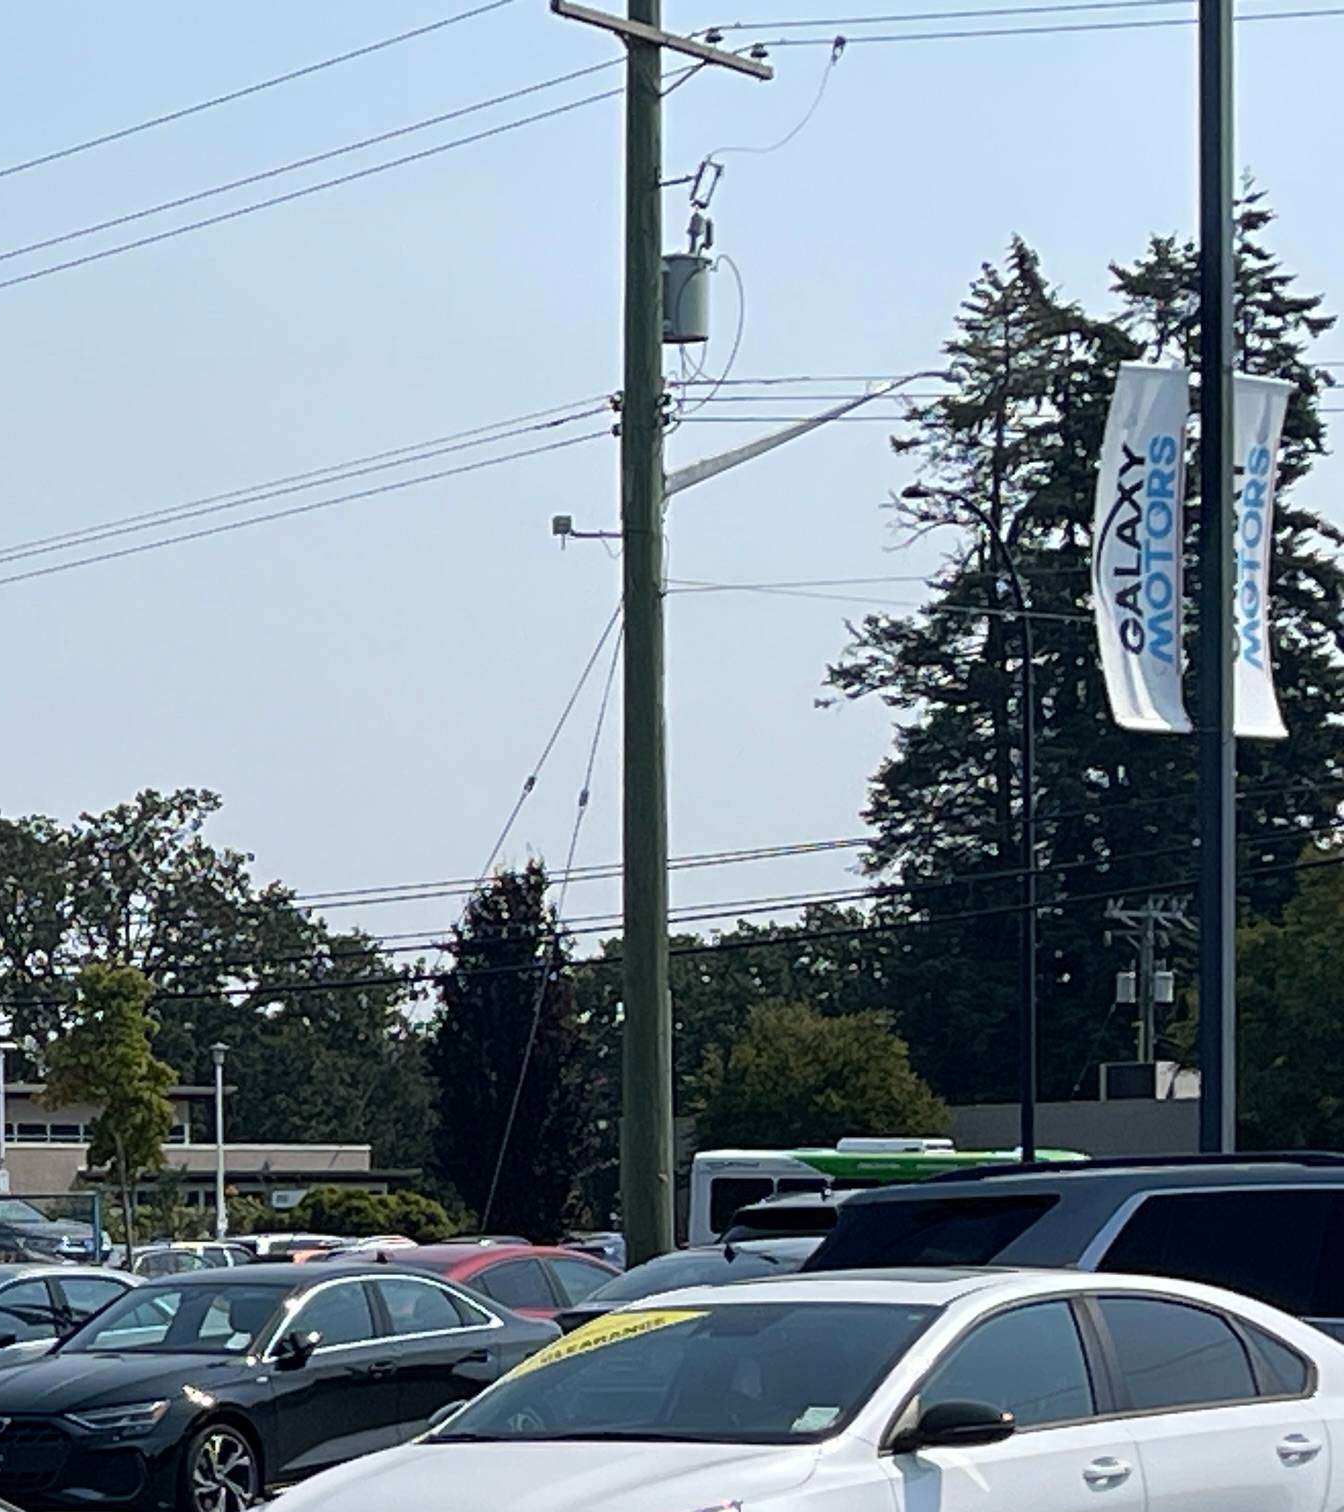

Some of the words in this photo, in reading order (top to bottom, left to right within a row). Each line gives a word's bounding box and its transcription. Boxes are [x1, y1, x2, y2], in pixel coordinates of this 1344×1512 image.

[1113, 443, 1146, 654] GALAXY
[1144, 434, 1178, 664] MOTORS
[1240, 446, 1272, 670] MOTORS
